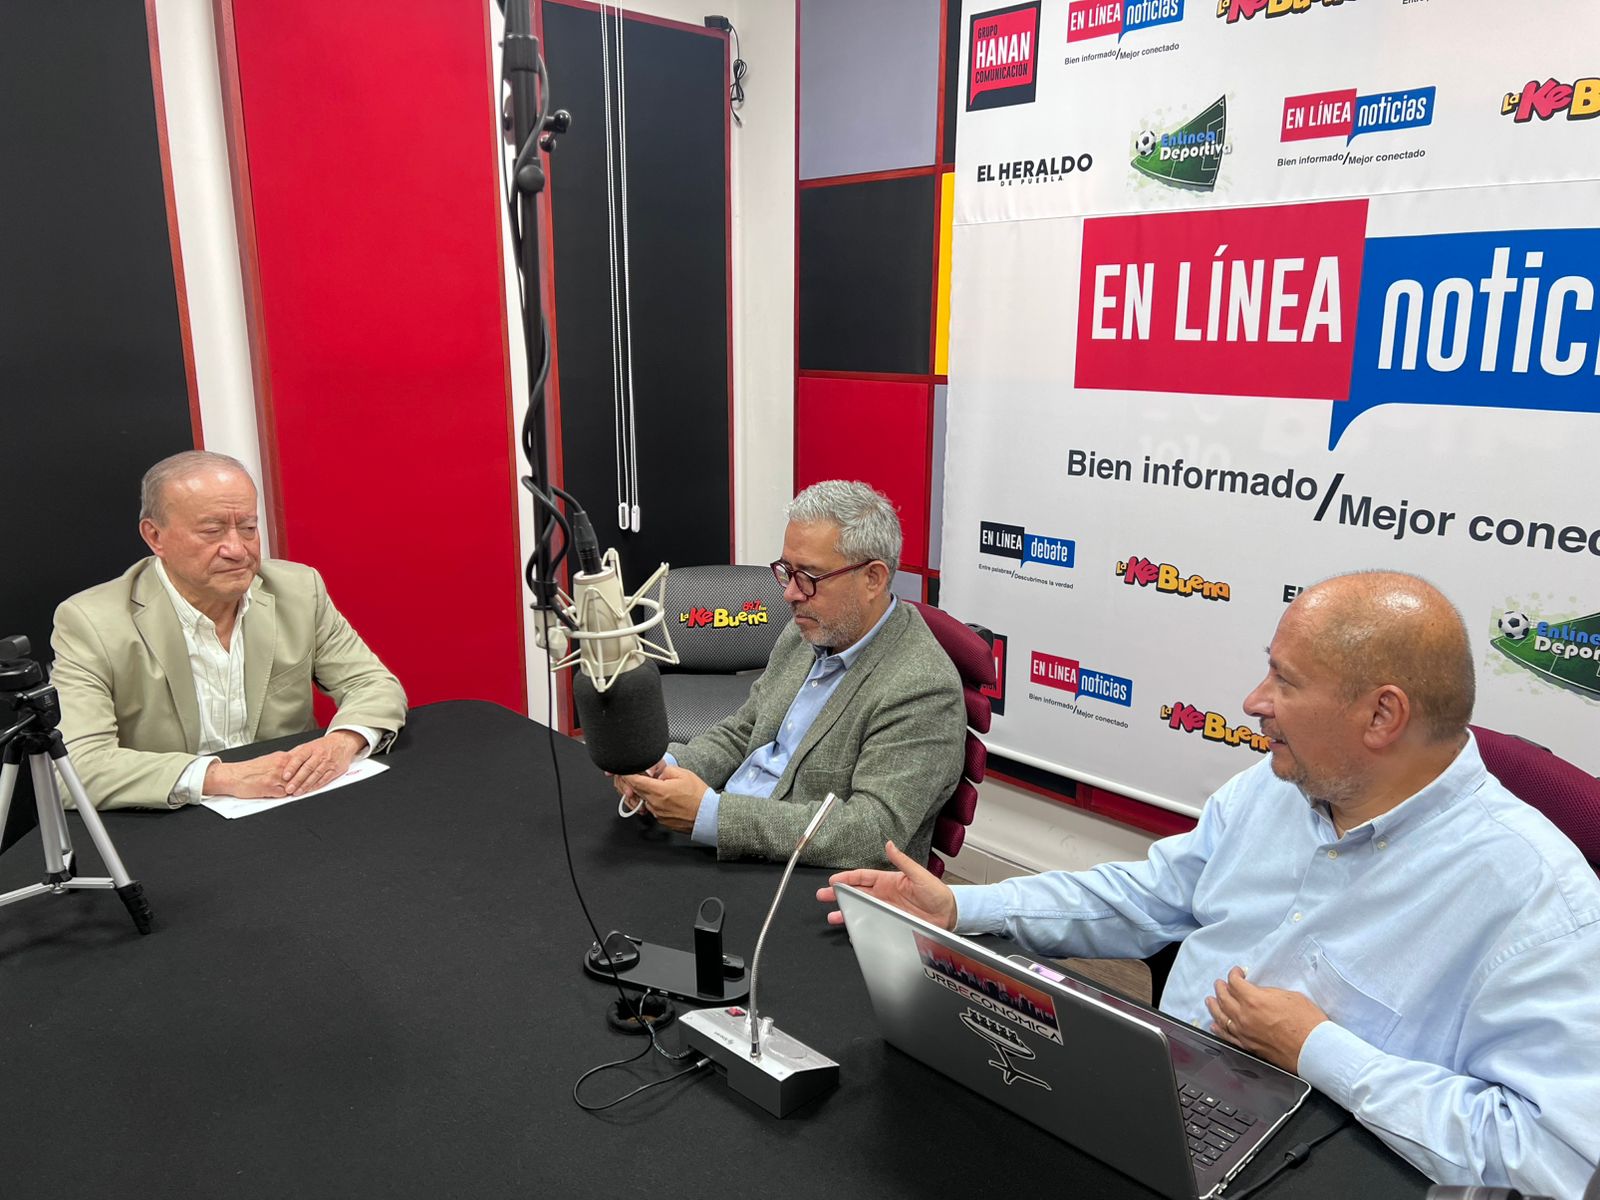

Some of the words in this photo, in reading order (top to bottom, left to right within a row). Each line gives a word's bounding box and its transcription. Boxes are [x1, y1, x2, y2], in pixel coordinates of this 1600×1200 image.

[1070, 10, 1085, 31] EN
[1088, 2, 1121, 28] LÍNEA
[1126, 0, 1179, 26] noticias
[977, 24, 998, 39] GRUPO
[976, 31, 1031, 69] HANAN
[1064, 57, 1080, 65] Bien
[1141, 43, 1180, 56] conectado
[1285, 107, 1305, 129] EN
[1308, 101, 1351, 127] LÍNEA
[1358, 95, 1427, 127] noticias
[1159, 141, 1232, 162] Deportiva
[1277, 158, 1297, 167] Bien
[1376, 149, 1426, 162] conectado
[977, 164, 995, 182] EL
[998, 153, 1093, 180] HERALDO
[1020, 175, 1063, 185] PUEBLA
[1091, 263, 1155, 341] EN
[1174, 244, 1342, 343] LÍNEA
[1377, 246, 1600, 377] notic
[1067, 449, 1133, 482] Bien
[982, 529, 994, 546] EN
[995, 530, 1023, 550] LÍNEA
[1030, 537, 1068, 562] debate
[978, 563, 991, 571] Entre
[1055, 581, 1074, 589] verdad
[1033, 659, 1046, 677] EN
[1048, 661, 1077, 684] LÍNEA
[1081, 673, 1127, 701] noticias
[1028, 693, 1042, 702] Bien
[1094, 714, 1129, 728] conectado
